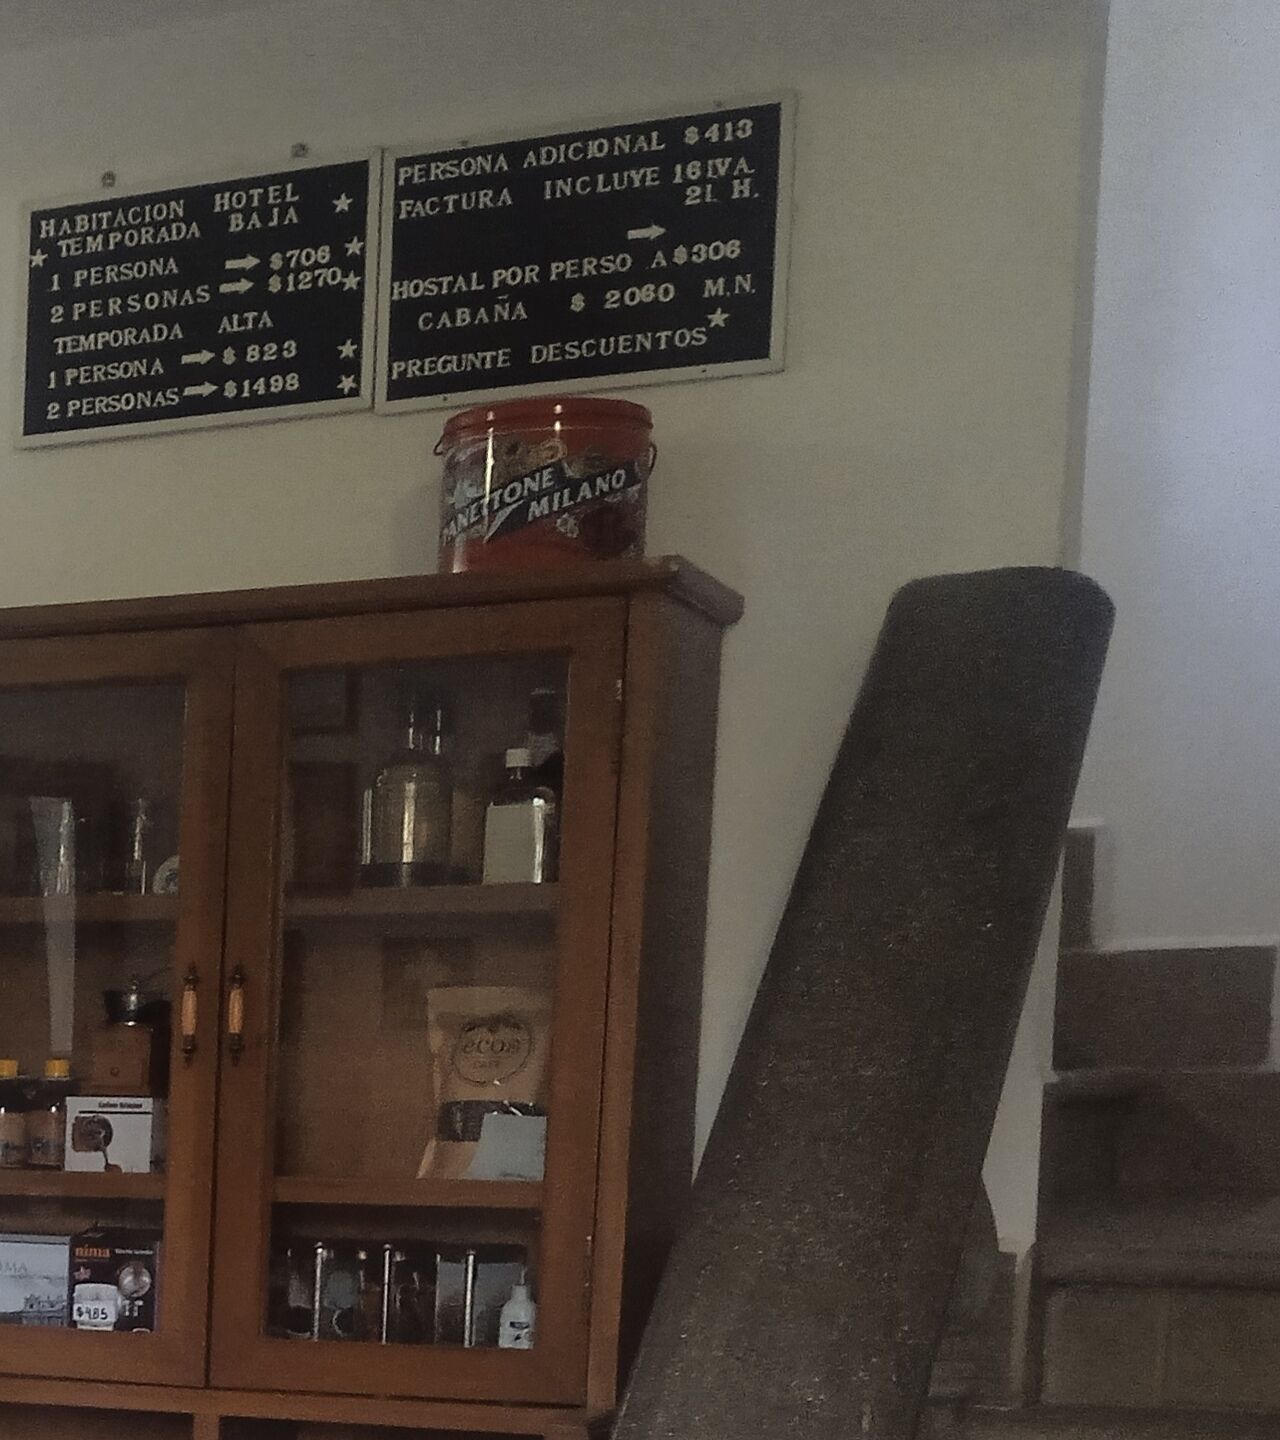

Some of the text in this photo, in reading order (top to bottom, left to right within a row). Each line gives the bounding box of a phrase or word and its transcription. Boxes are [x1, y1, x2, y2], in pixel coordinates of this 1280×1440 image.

[398, 118, 753, 186] PERSONA ADICIONAL $413
[40, 182, 299, 239] HABITACION HOTEL
[398, 189, 513, 220] FACTURA
[543, 168, 660, 201] INCLUYE
[58, 205, 299, 258] TEMPORADA BAJA
[50, 273, 60, 292] 1
[73, 257, 179, 289] PERSONA
[50, 266, 342, 324] 2 PERSONAS $1270
[392, 270, 485, 301] HOSTAL
[491, 264, 540, 289] POR
[548, 252, 632, 282] PERSO
[417, 294, 528, 332] CABAÑA
[702, 273, 757, 299] M.N.
[53, 310, 274, 355] TEMPORADA ALTA
[391, 327, 708, 381] PREGUNTE DESCUENTOS
[45, 372, 301, 420] 2 PERSONAS $1498
[47, 370, 56, 389] 1
[64, 358, 165, 386] PERSONA
[527, 468, 627, 523] MILANO
